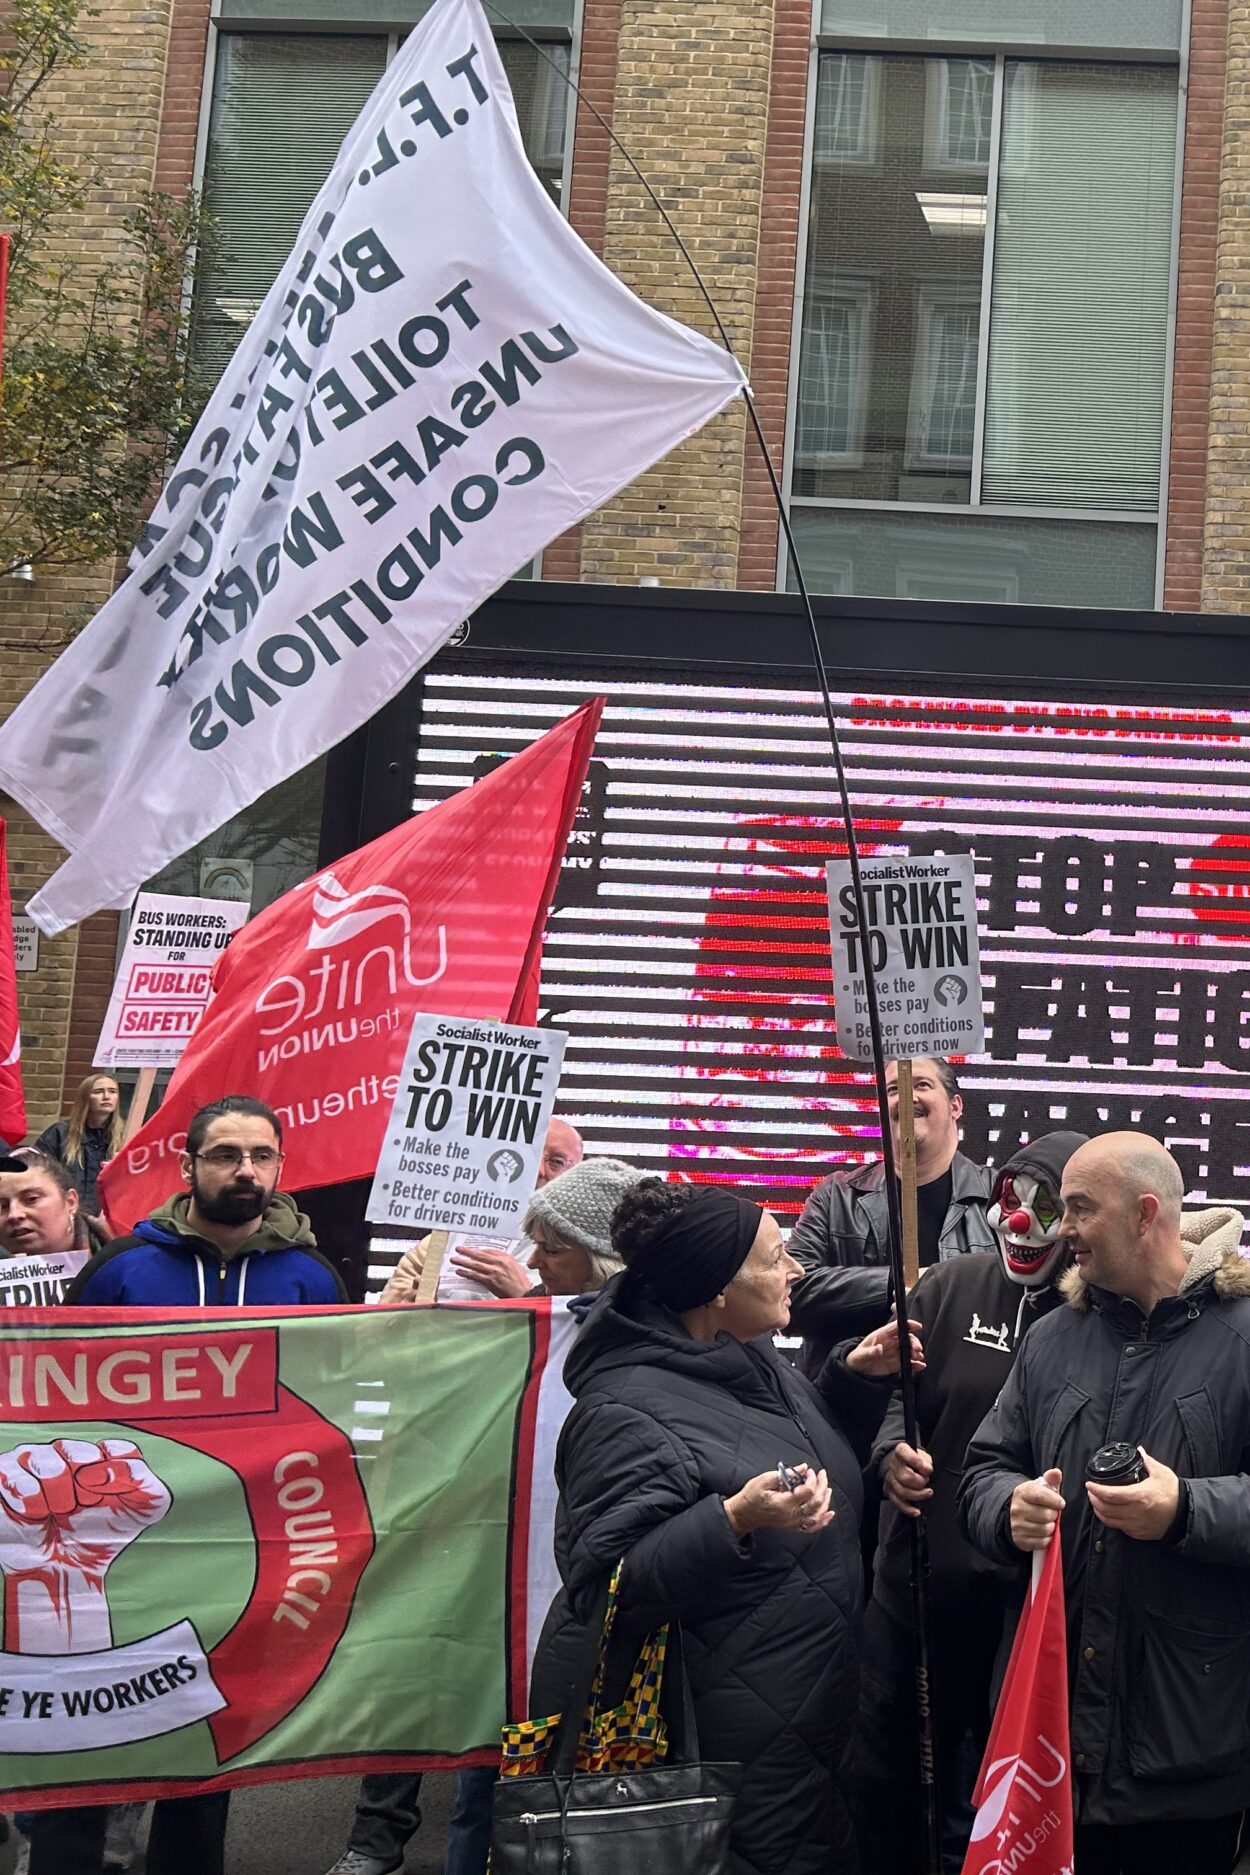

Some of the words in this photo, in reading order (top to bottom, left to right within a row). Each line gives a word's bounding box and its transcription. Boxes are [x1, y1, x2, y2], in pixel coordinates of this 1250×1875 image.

[852, 866, 905, 880] ocialist
[918, 830, 1177, 938] TOP
[839, 881, 965, 928] STRIKE
[137, 911, 164, 925] BUS
[165, 913, 227, 928] WORKERS:
[13, 935, 29, 943] dge
[133, 928, 212, 949] STANDING
[840, 929, 888, 973] TO
[900, 925, 968, 970] WIN
[167, 951, 186, 961] FOR
[133, 972, 207, 994] PUBLIC
[853, 979, 888, 996] Mke
[893, 977, 915, 993] the
[854, 996, 902, 1014] boses
[906, 998, 929, 1014] pay
[123, 1011, 199, 1032] SAFETY
[855, 1023, 899, 1039] Beter
[903, 1017, 973, 1035] conditions
[857, 1041, 872, 1056] fo
[883, 1039, 929, 1055] drivers
[933, 1037, 959, 1051] now
[412, 1040, 549, 1098] STRIKE
[405, 1085, 453, 1132] TO
[465, 1093, 541, 1144] WIN
[402, 1136, 441, 1156] Make
[446, 1142, 469, 1159] the
[398, 1154, 449, 1176] bosses
[452, 1168, 480, 1184] pay
[391, 1180, 440, 1201] Better
[443, 1187, 519, 1212] conditions
[388, 1201, 411, 1218] for
[414, 1203, 465, 1225] drivers
[469, 1213, 499, 1229] now
[0, 1266, 28, 1281] cialist
[9, 1344, 253, 1407] INGEY
[272, 1451, 338, 1630] COUNCIL
[22, 1690, 54, 1719] YE
[61, 1655, 197, 1717] WORKERS
